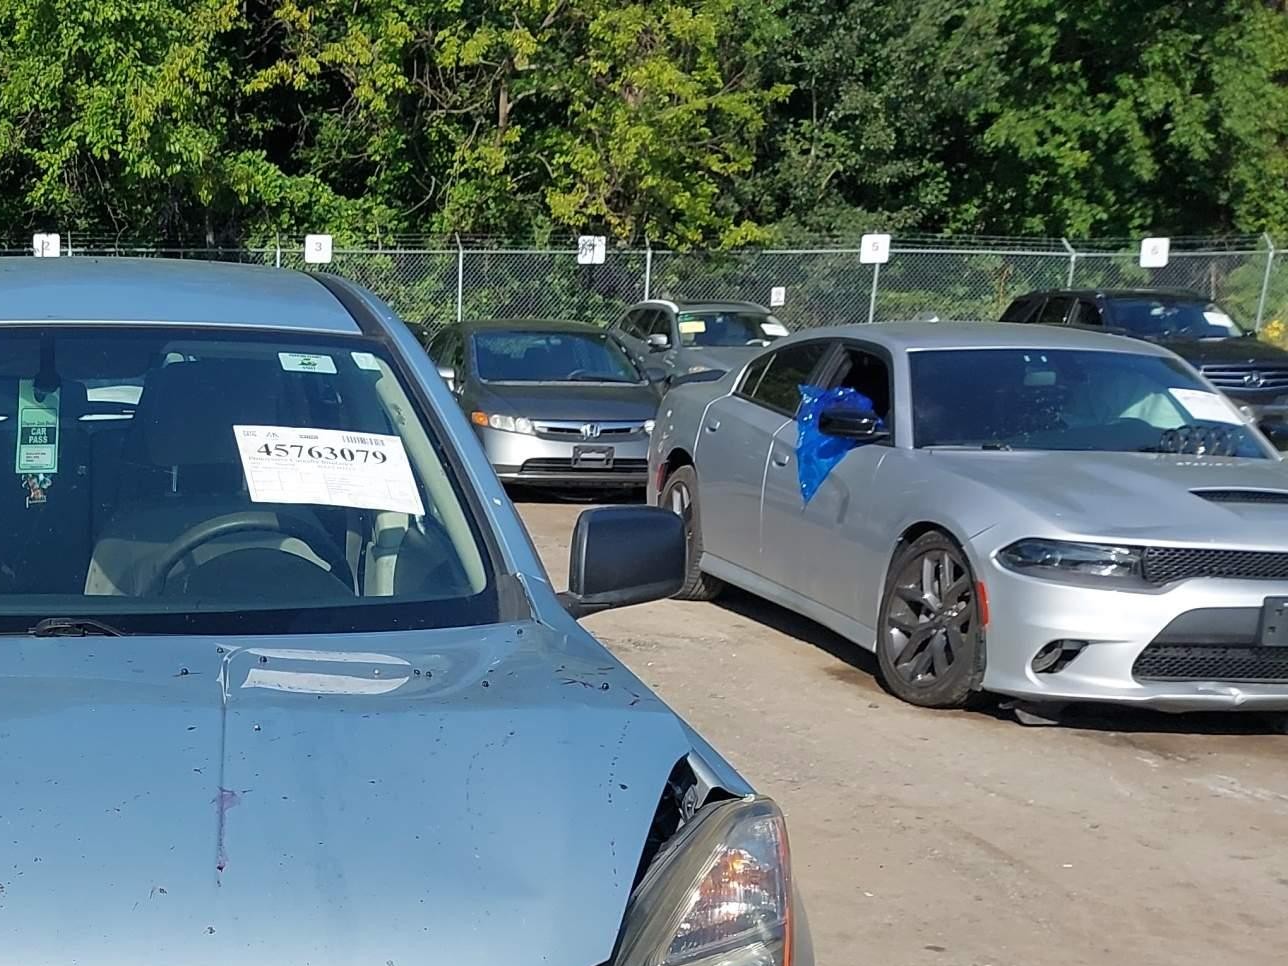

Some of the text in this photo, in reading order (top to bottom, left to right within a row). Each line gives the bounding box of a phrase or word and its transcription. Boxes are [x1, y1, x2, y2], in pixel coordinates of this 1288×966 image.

[43, 241, 50, 251] 2
[314, 242, 322, 251] 3
[871, 242, 879, 251] 5
[31, 427, 47, 436] CAR
[28, 435, 48, 444] PASS
[256, 443, 387, 465] 45763079
